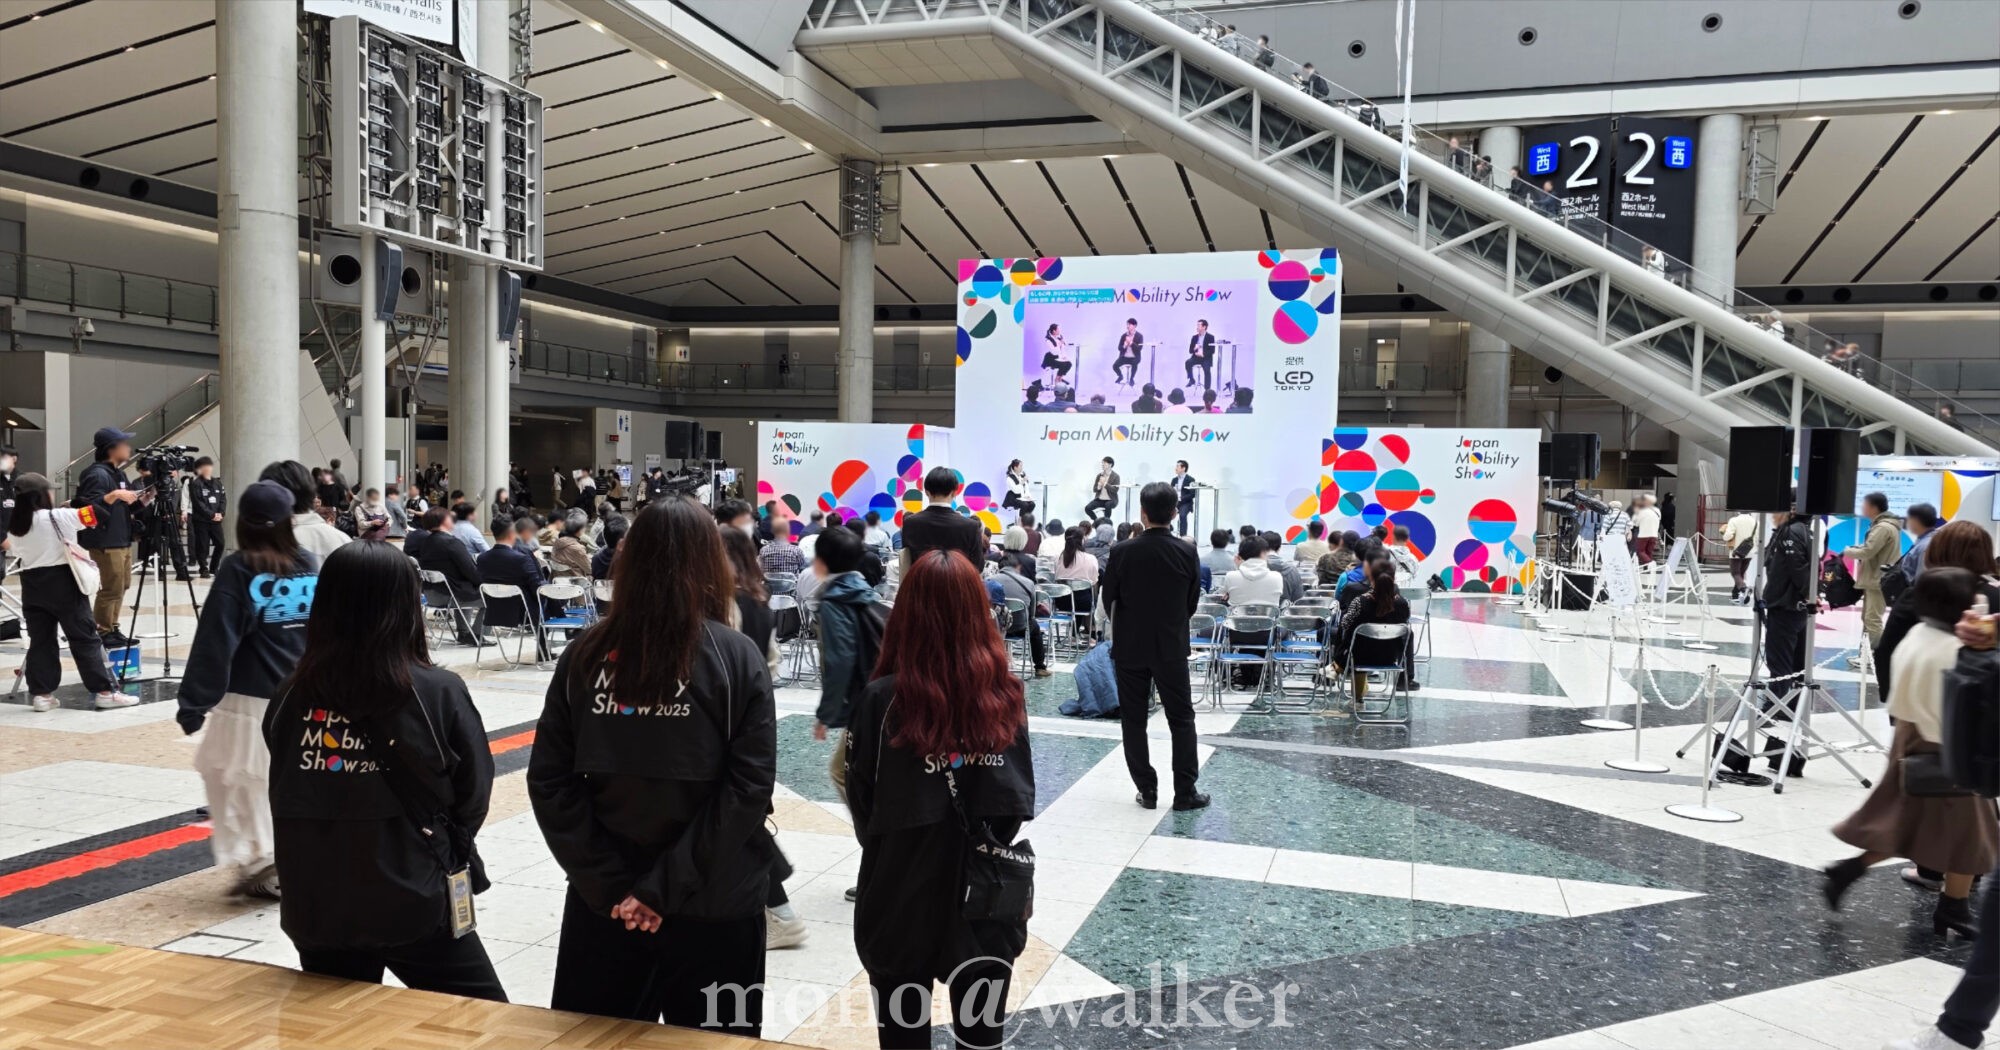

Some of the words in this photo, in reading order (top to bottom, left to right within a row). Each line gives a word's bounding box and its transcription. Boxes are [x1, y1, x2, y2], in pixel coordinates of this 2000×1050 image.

[1536, 146, 1551, 154] West
[1672, 139, 1685, 147] West
[1536, 154, 1550, 172] 西
[1566, 136, 1600, 188] 2
[1624, 132, 1656, 185] 2
[1672, 148, 1685, 165] 西
[1560, 194, 1600, 207] 西2ホール
[1621, 192, 1657, 203] 西2ホール
[1621, 202, 1637, 211] West
[1637, 203, 1650, 211] Hall
[1650, 204, 1655, 212] 2
[1113, 286, 1180, 306] Mobility
[1185, 285, 1232, 302] Show
[1274, 371, 1314, 385] LED
[772, 427, 805, 442] Japan
[1040, 424, 1091, 446] Japan
[1096, 423, 1174, 447] Mobility
[1178, 424, 1231, 443] Show
[772, 441, 820, 457] Mobility
[1455, 435, 1500, 451] Japan
[772, 454, 803, 466] Show
[1455, 450, 1520, 468] Mobility
[1454, 465, 1496, 480] Show
[591, 692, 652, 716] Show
[655, 703, 691, 717] 2025
[299, 749, 358, 773] Show
[359, 761, 391, 774] 20
[978, 753, 1005, 767] 2025
[945, 770, 958, 798] FILA
[992, 846, 1015, 860] FILA
